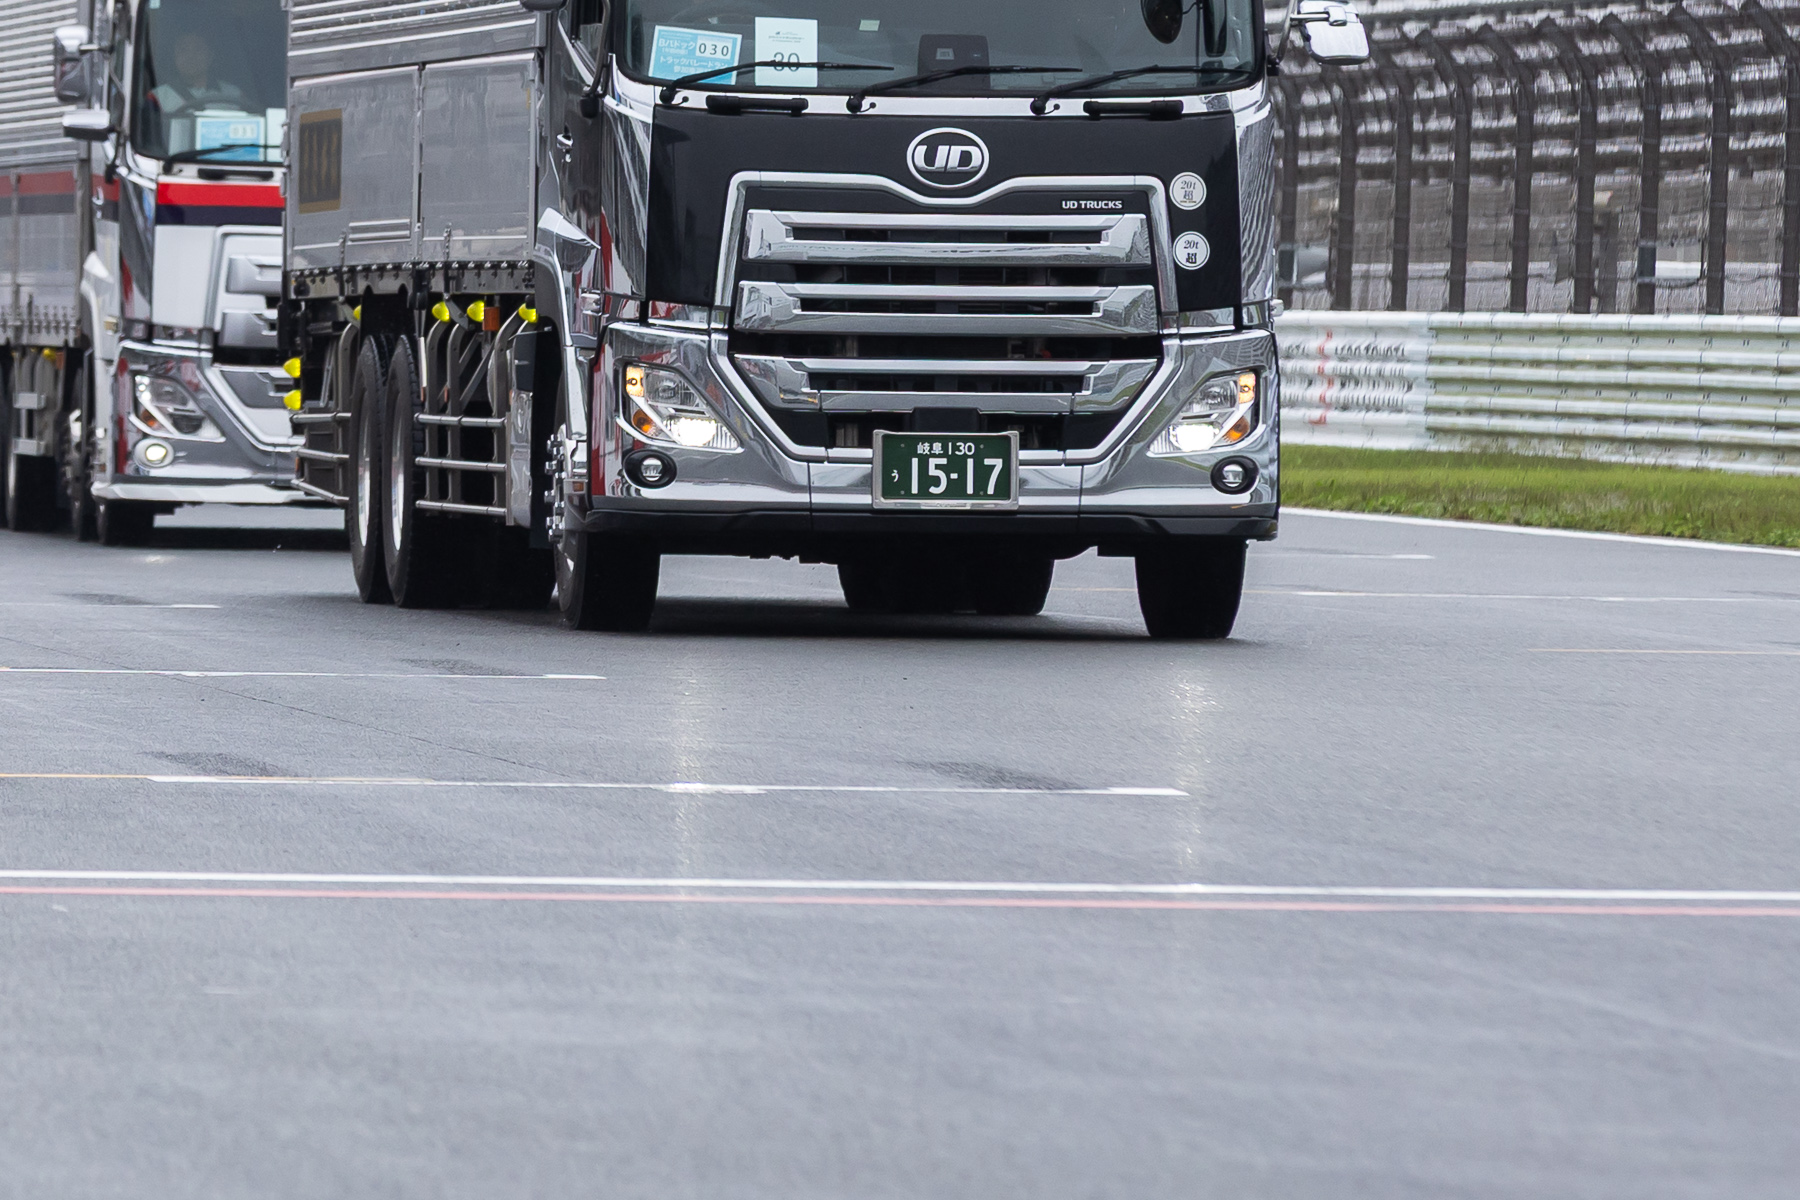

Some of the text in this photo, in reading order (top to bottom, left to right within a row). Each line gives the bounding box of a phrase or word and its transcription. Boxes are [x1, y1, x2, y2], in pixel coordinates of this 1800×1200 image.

[698, 42, 729, 56] 030
[913, 144, 983, 173] UD
[1062, 200, 1123, 209] UD TRUCKS
[1183, 240, 1199, 250] 20t
[917, 441, 975, 455] 岐阜 130
[891, 457, 1003, 495] う 15-17
